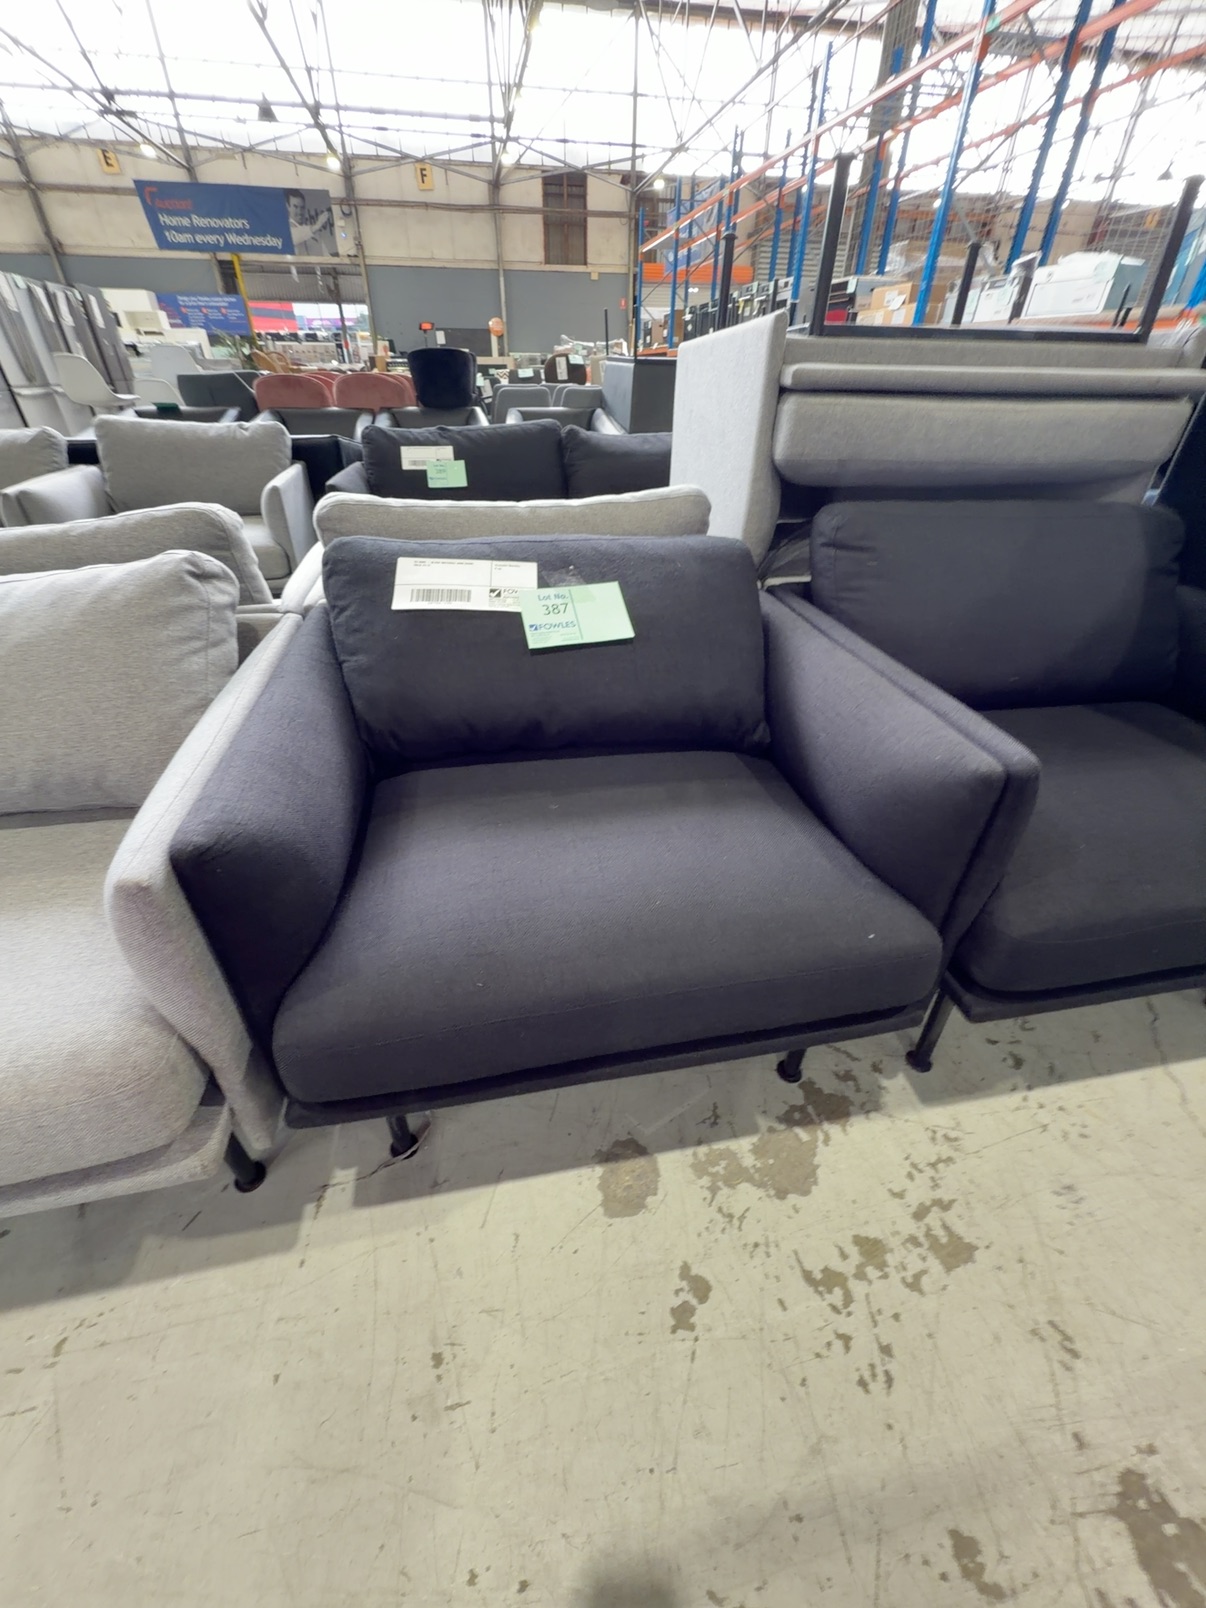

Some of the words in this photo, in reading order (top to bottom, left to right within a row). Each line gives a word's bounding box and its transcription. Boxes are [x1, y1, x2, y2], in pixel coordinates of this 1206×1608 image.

[101, 149, 114, 168] E
[419, 167, 427, 184] F
[158, 213, 191, 227] Home
[190, 214, 250, 230] Renovators
[165, 230, 194, 243] 10am
[195, 233, 225, 247] every
[223, 232, 283, 249] Wednesday
[537, 594, 551, 602] Lot
[541, 602, 569, 616] 387
[538, 620, 577, 631] FOWLES
